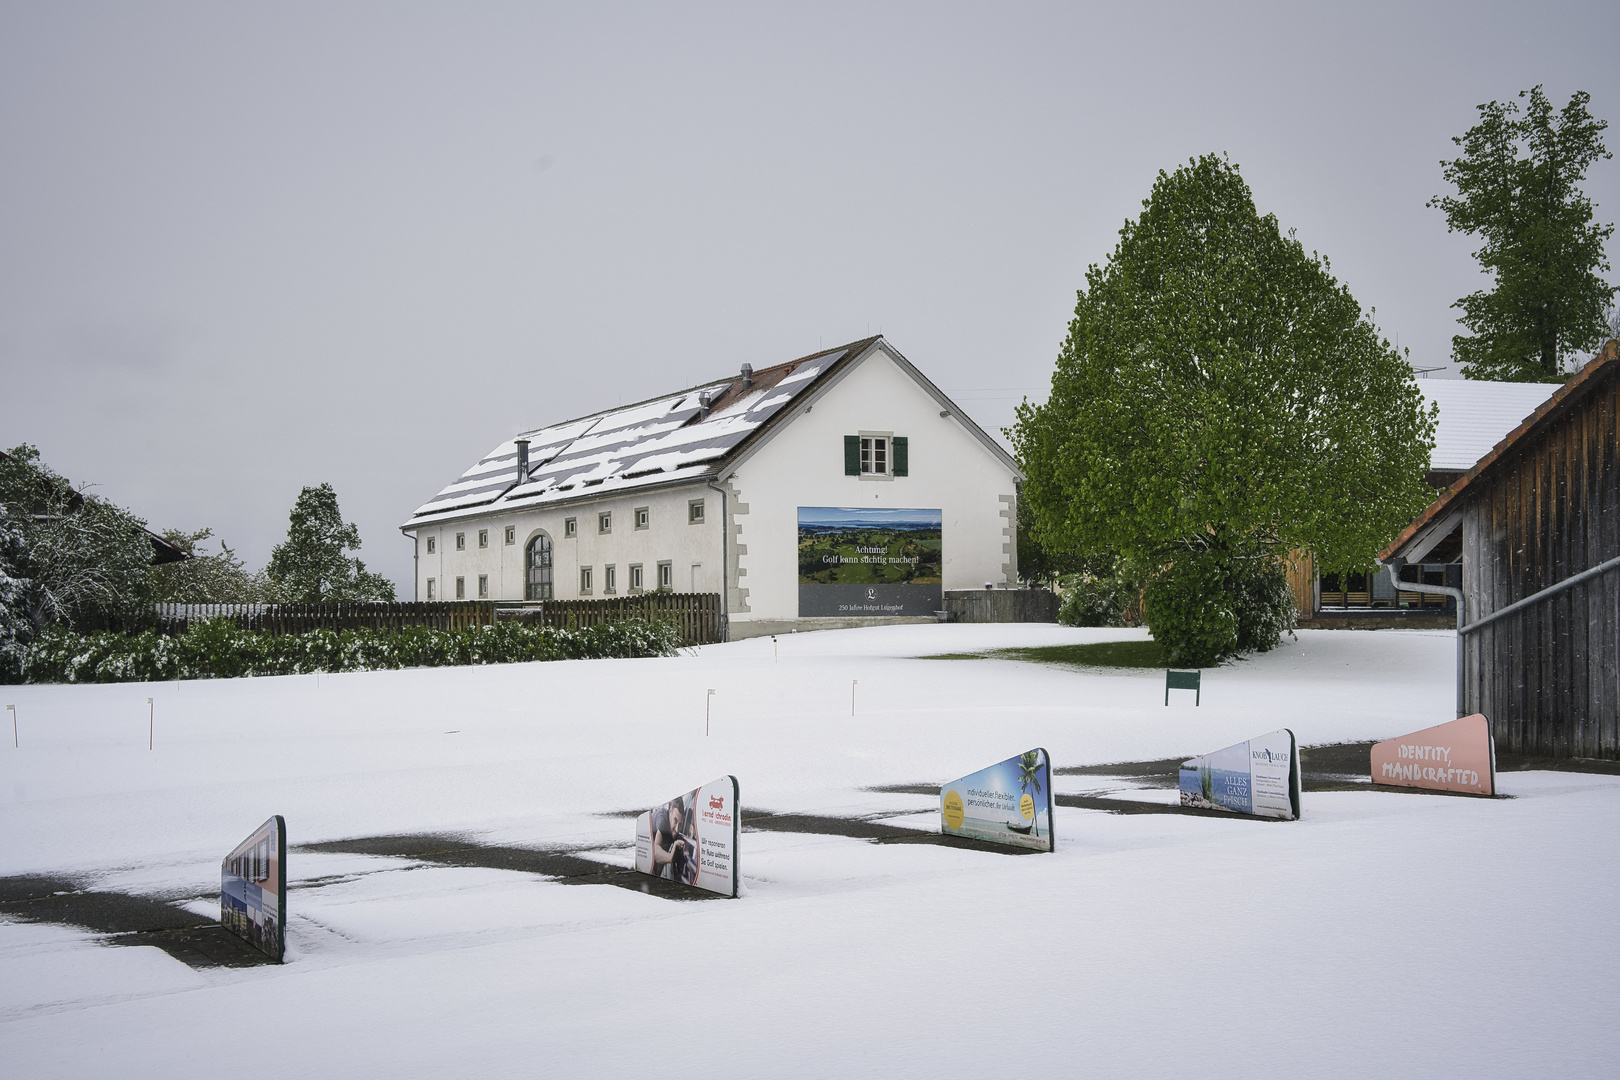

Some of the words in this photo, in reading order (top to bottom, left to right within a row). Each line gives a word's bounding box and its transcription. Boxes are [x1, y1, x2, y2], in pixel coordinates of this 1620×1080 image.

[855, 546, 888, 555] Achtung!
[822, 555, 838, 564] Golf
[840, 555, 859, 564] kann
[860, 555, 887, 565] süchtig
[888, 555, 919, 564] machen!
[863, 604, 880, 612] Hofgut
[1252, 751, 1267, 760] KNOB
[1398, 744, 1452, 768] IDENTITY,
[1382, 762, 1482, 789] HANDCRAFTED.
[1224, 776, 1247, 786] ALLES
[1227, 786, 1248, 796] GANZ
[707, 859, 715, 867] Golf
